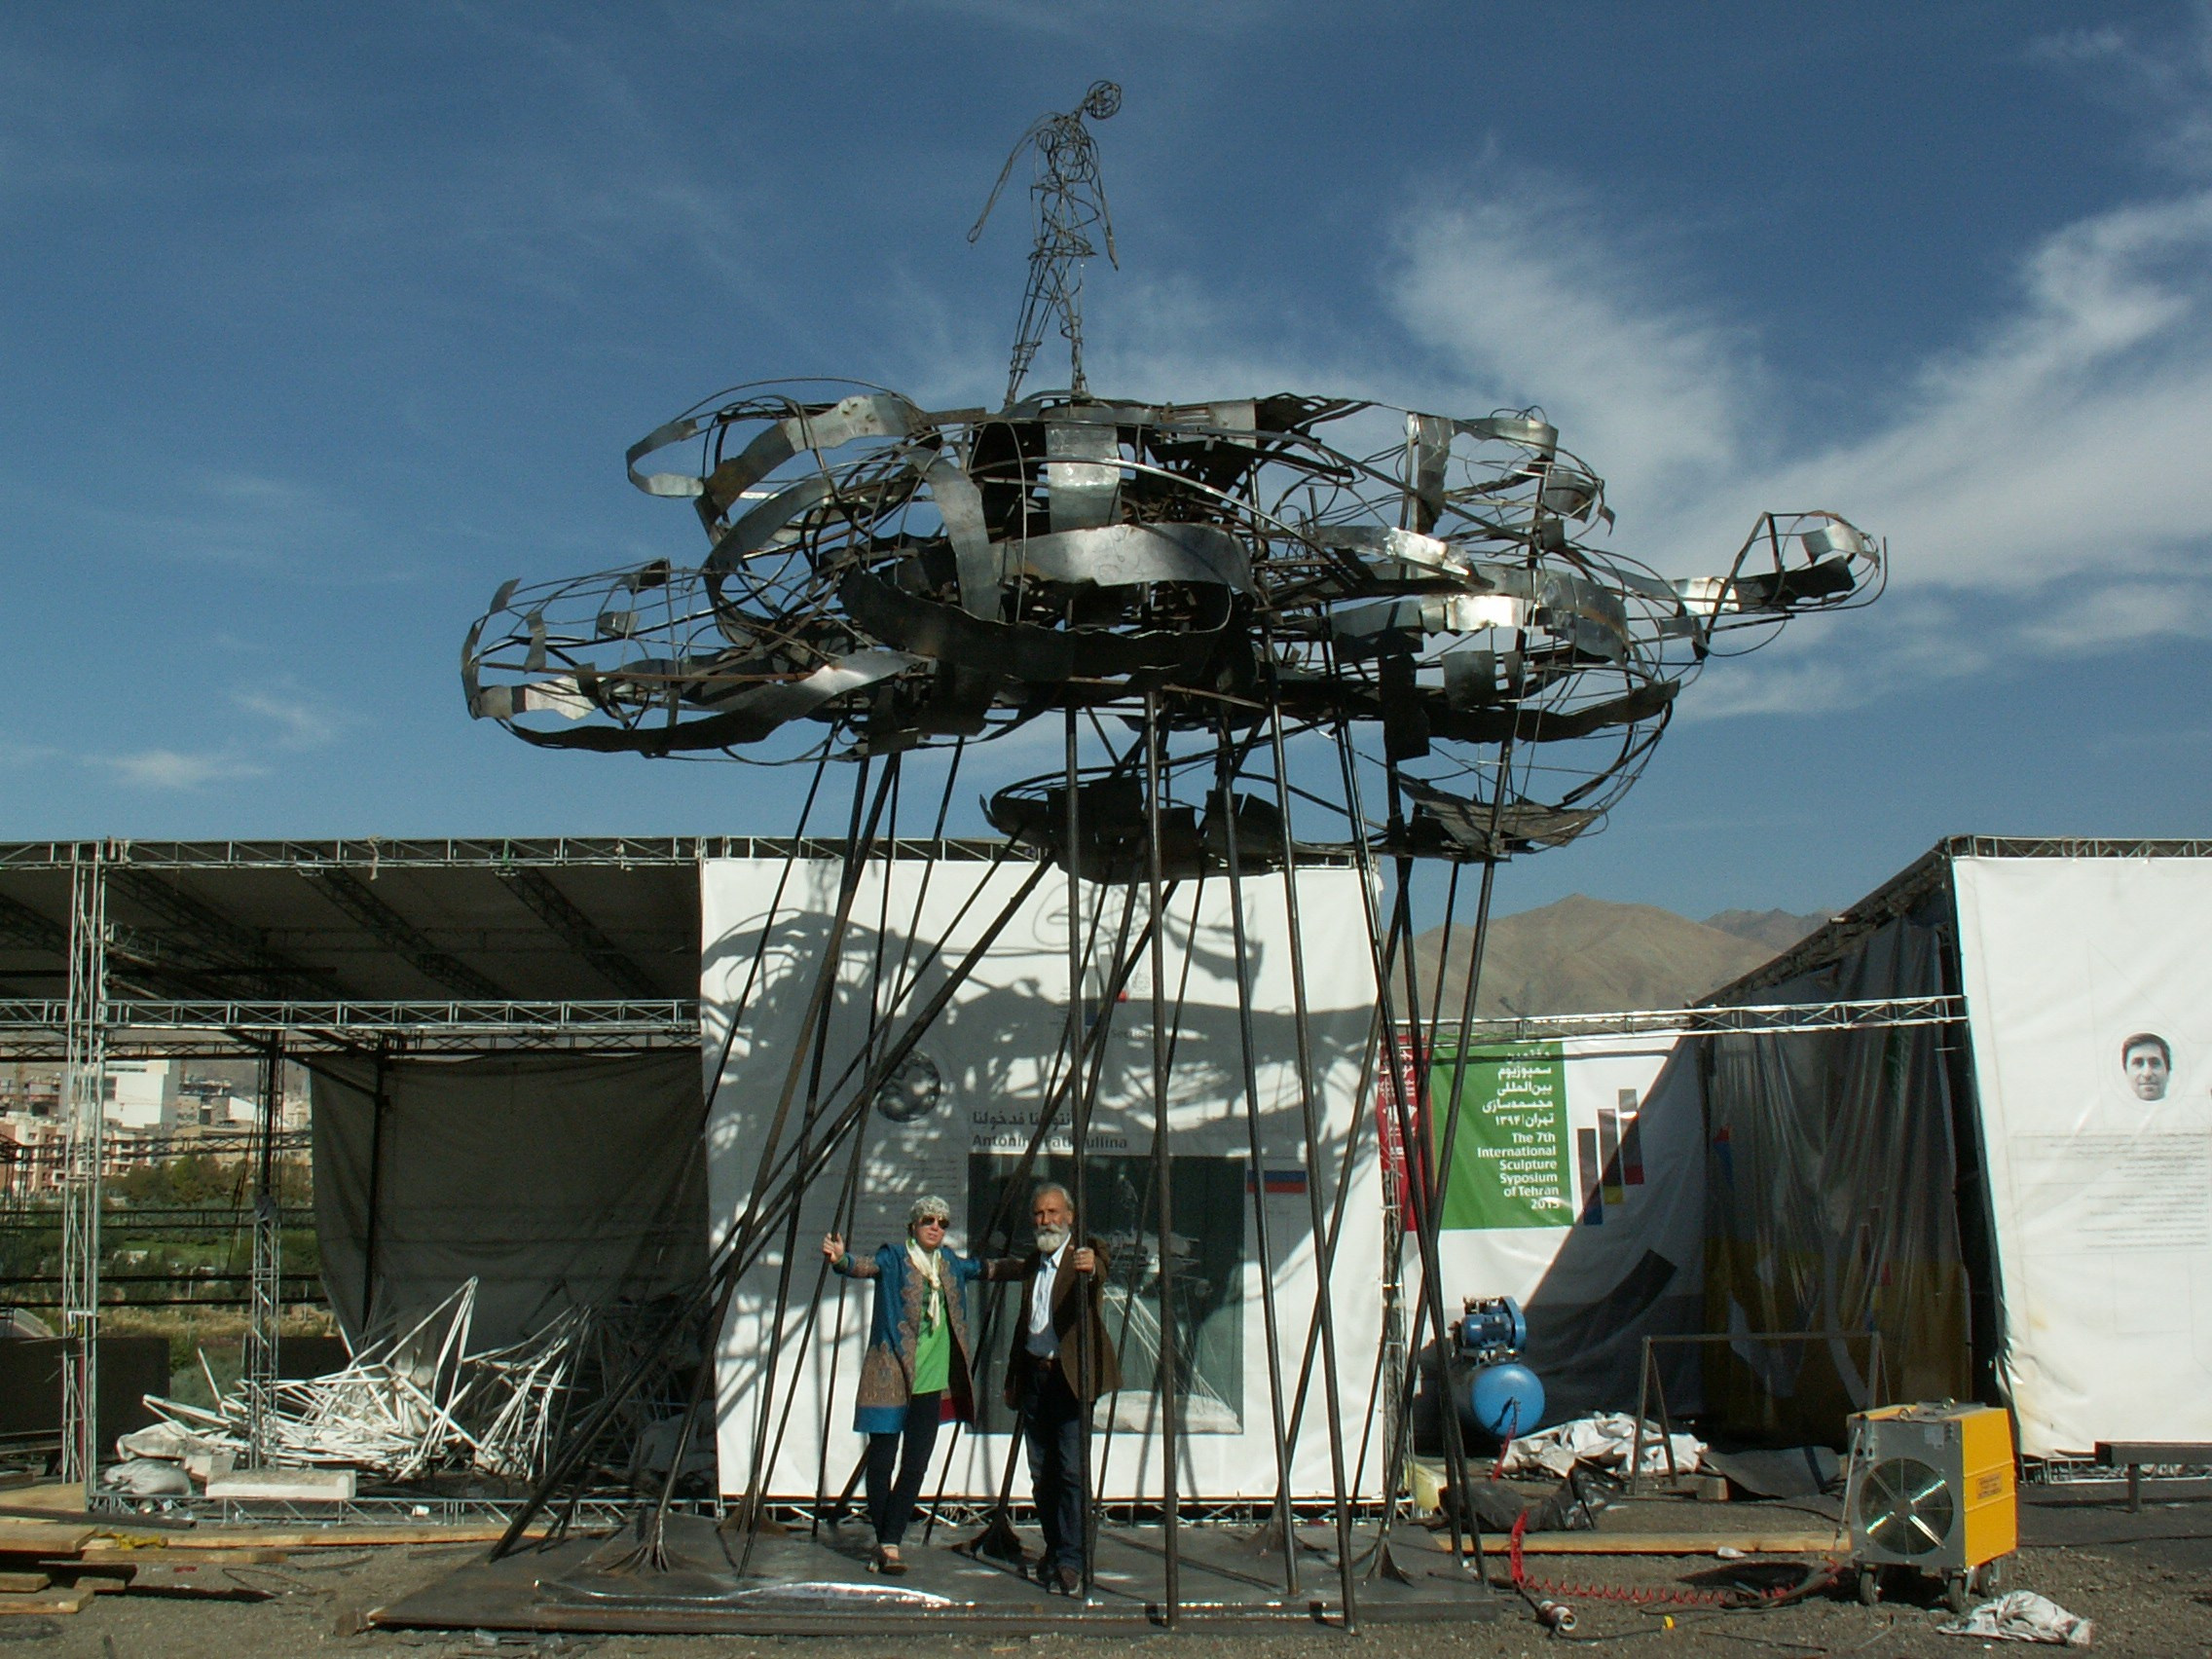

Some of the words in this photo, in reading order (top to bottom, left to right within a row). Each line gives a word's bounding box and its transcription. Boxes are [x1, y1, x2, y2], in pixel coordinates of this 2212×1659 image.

[1512, 1132, 1534, 1144] The
[1536, 1131, 1556, 1143] 7th
[1477, 1145, 1557, 1158] International
[1499, 1160, 1558, 1172] Sculpture
[1499, 1172, 1559, 1186] Syposium
[1503, 1186, 1516, 1198] of
[1518, 1186, 1560, 1197] Tehran
